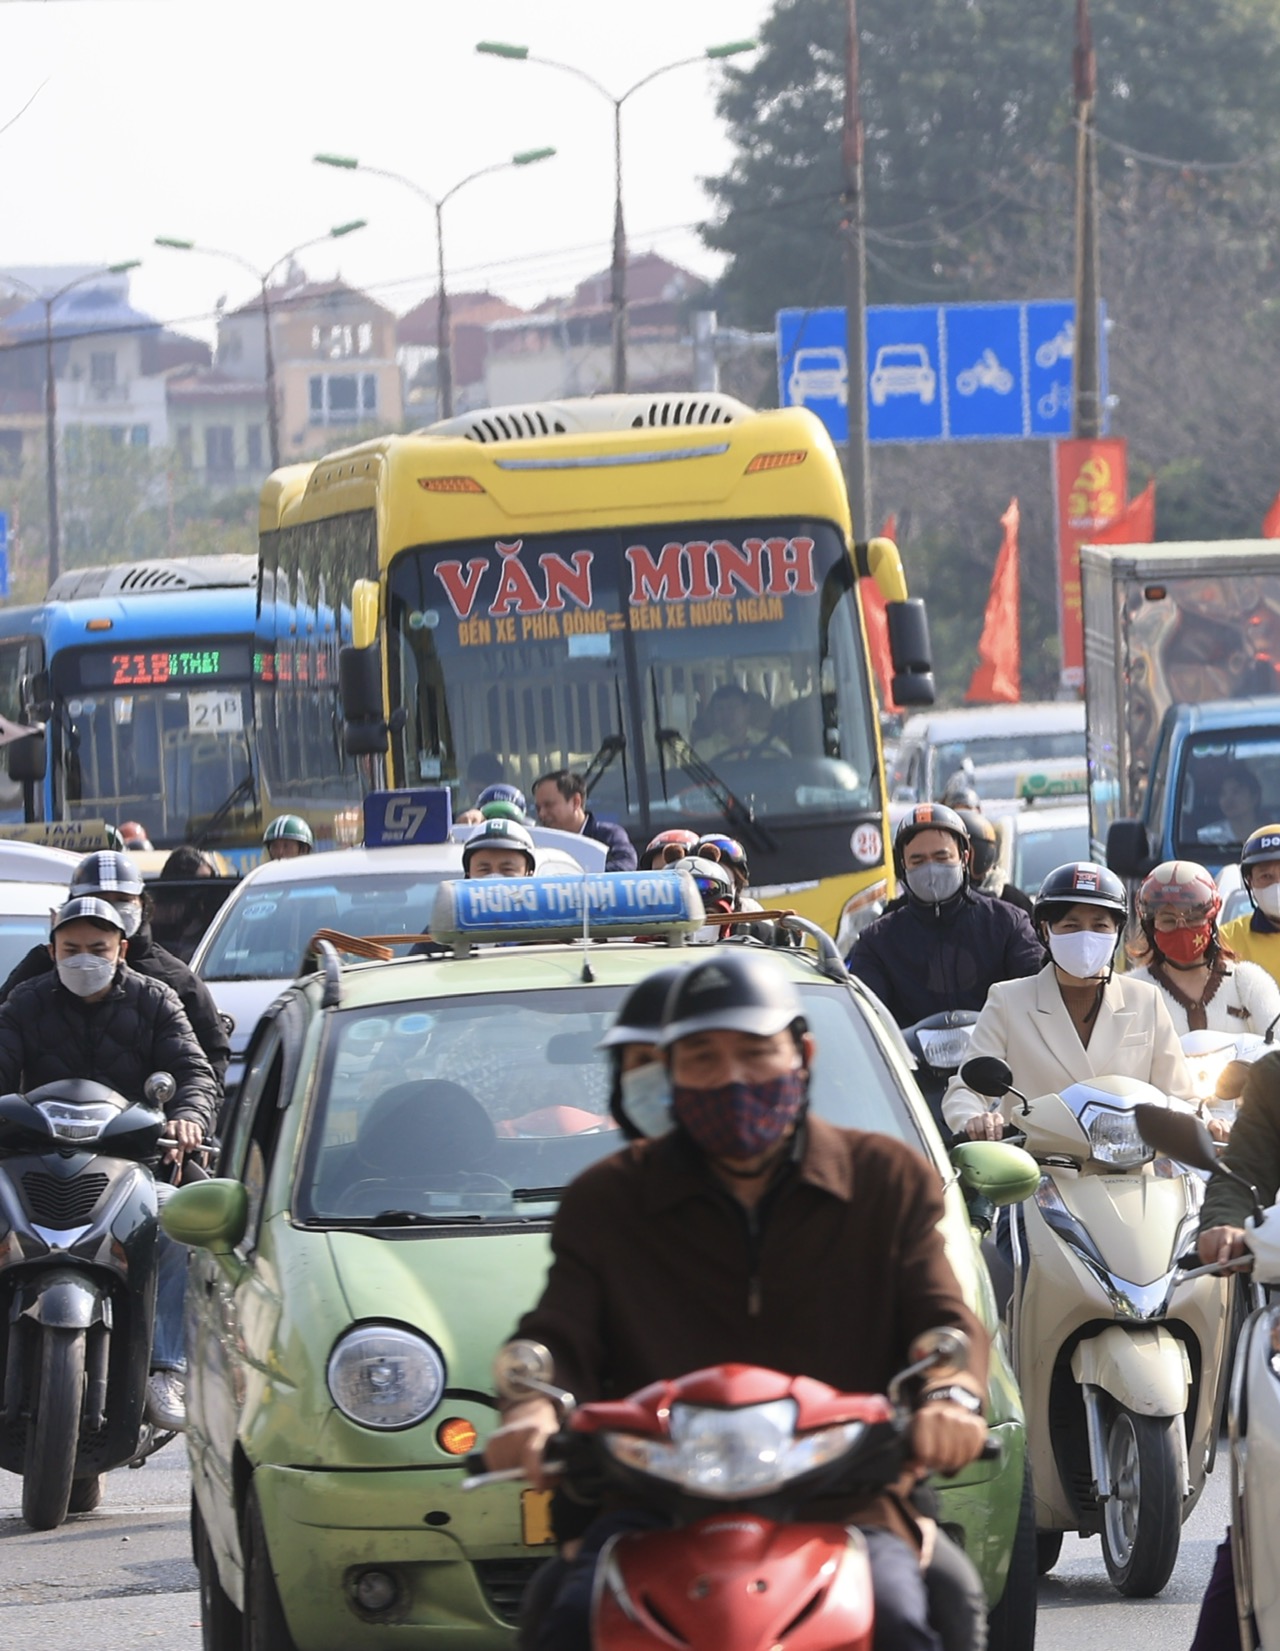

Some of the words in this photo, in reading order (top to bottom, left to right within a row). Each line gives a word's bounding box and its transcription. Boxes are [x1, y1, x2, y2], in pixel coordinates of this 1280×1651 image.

[434, 539, 594, 618] VĂN
[625, 537, 817, 605] MINH
[495, 617, 516, 643] XE
[562, 606, 607, 637] ĐÔNG
[666, 603, 686, 628] XE
[195, 699, 237, 726] 21B
[44, 822, 83, 834] TAXI
[384, 796, 427, 840] G7
[541, 880, 617, 918] THỊNH
[620, 879, 675, 909] TAXI
